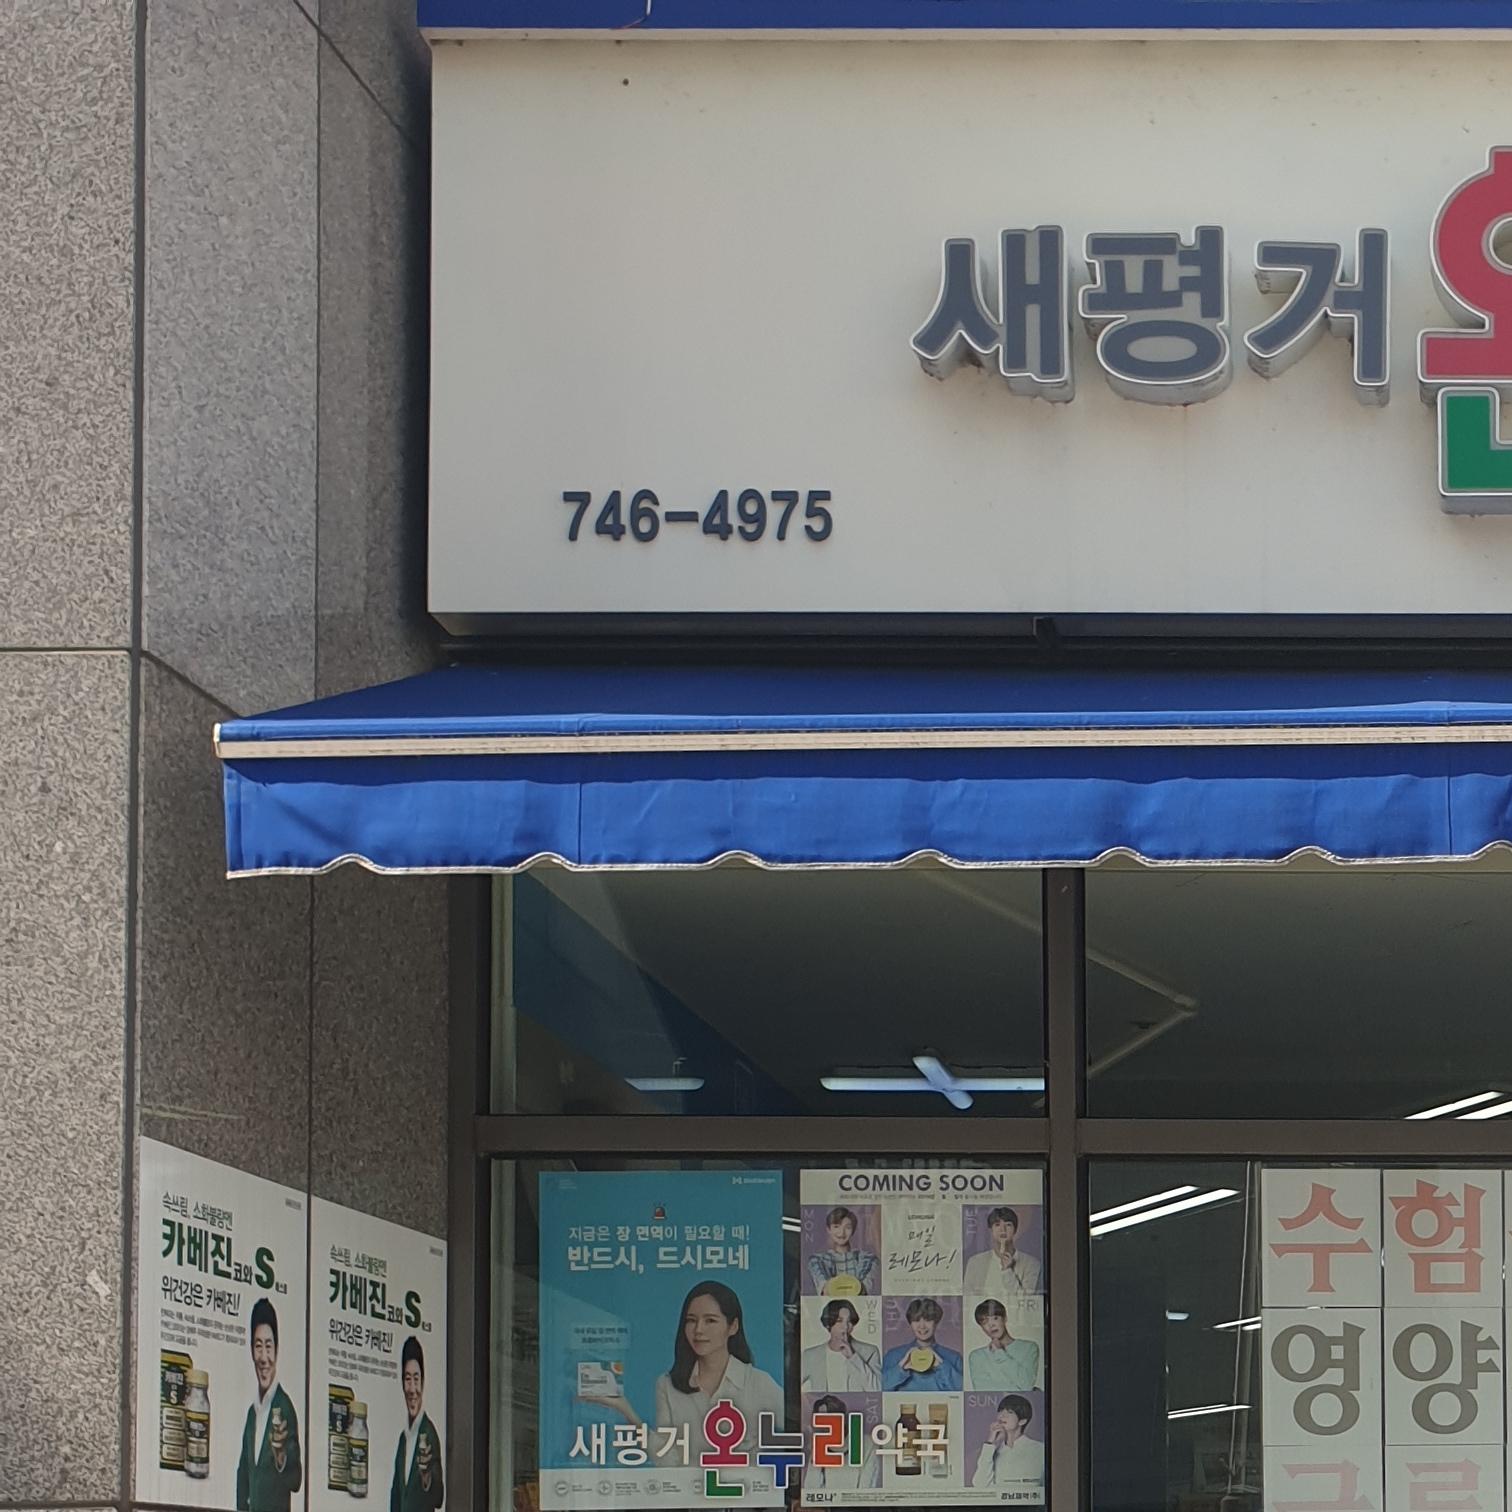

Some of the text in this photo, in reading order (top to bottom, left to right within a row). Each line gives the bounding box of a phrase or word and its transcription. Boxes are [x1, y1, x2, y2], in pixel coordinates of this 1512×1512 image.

[562, 488, 833, 542] 746-4975
[838, 1174, 1005, 1192] COMING SOON
[569, 1225, 750, 1241] 지금은 장 면역이 필요할 때!
[907, 1226, 936, 1248] 매일
[567, 1244, 749, 1274] 반드시, 드시모네
[866, 1301, 878, 1335] WED
[968, 1396, 998, 1407] SUN
